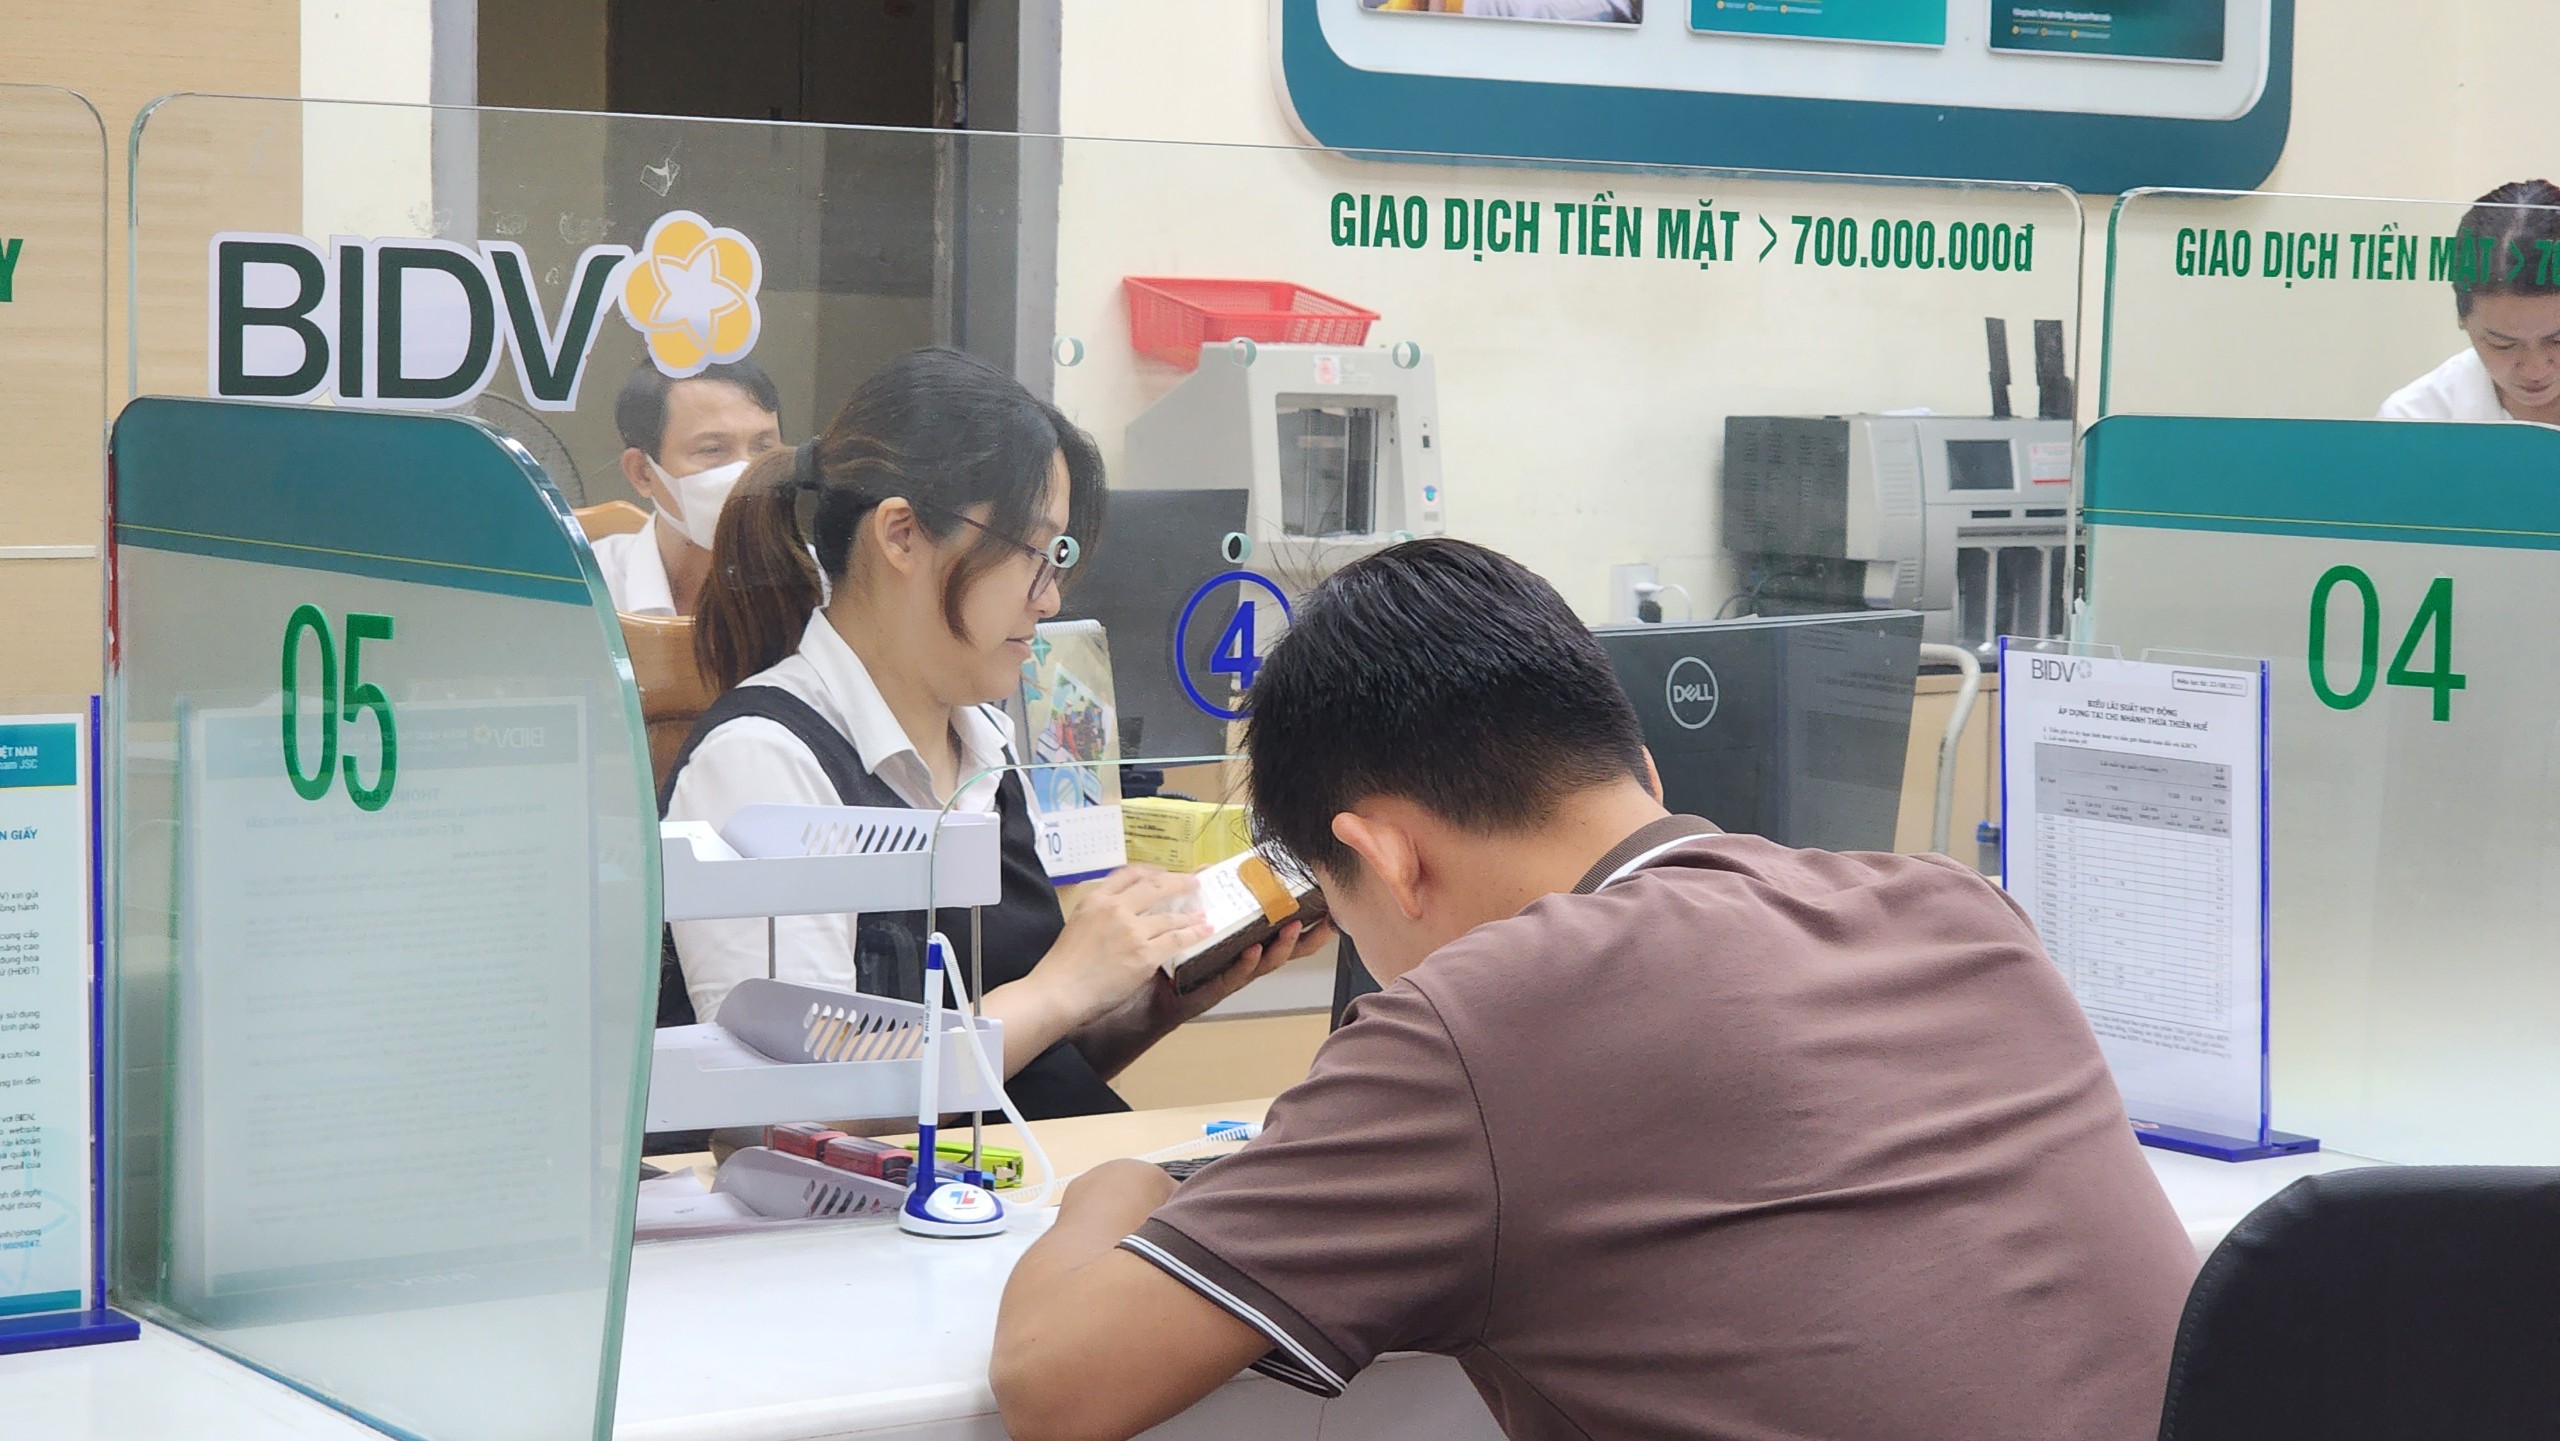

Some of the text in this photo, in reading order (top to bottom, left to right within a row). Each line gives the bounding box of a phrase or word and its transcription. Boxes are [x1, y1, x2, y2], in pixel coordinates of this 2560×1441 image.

[1331, 192, 1428, 249] GIAO
[1444, 198, 1540, 262] DỊCH
[1554, 190, 1642, 258] TIỀN
[1657, 198, 1740, 270] MẶT
[1791, 215, 2035, 272] 700.000.000đ
[2175, 227, 2251, 277] GIAO
[2263, 230, 2338, 289] DỊCH
[2350, 222, 2418, 281] TIỀN
[2429, 227, 2497, 291] MẶT
[218, 240, 625, 403] BIDV
[1210, 601, 1264, 690] 4
[2032, 658, 2076, 682] BIDV
[2308, 564, 2466, 722] 04
[281, 603, 396, 812] 05
[1673, 683, 1713, 703] DELL
[15, 746, 38, 757] NAM
[1046, 832, 1062, 855] 10
